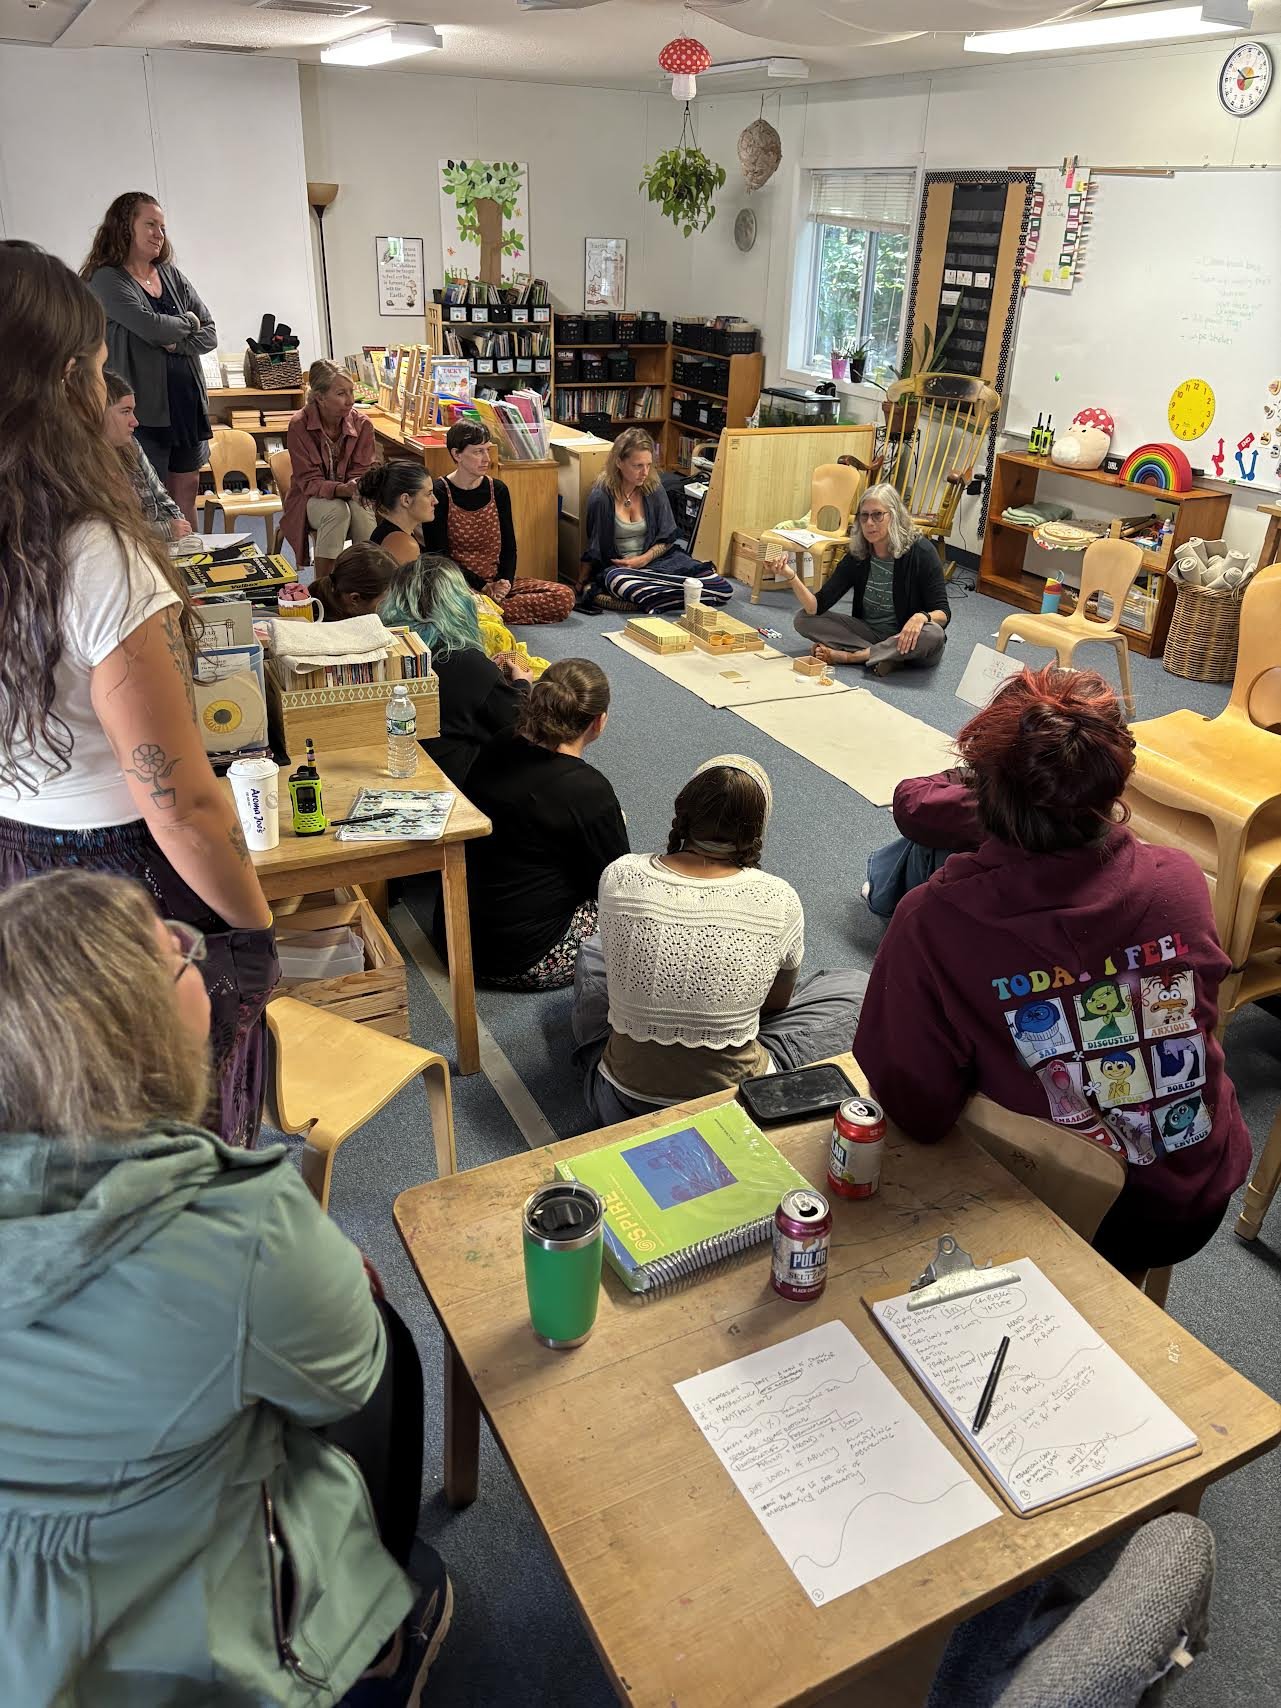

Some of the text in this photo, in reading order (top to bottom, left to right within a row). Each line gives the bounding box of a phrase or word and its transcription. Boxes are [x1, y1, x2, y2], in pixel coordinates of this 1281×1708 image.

[1241, 437, 1251, 447] END
[1107, 461, 1118, 471] JBL
[251, 788, 266, 834] Aroma Joe's
[1124, 933, 1189, 970] FEEL
[1151, 1021, 1191, 1037] ANXIOUS
[1087, 1034, 1135, 1049] DISGUSTED
[1039, 1047, 1057, 1058] SAD
[1166, 1081, 1196, 1093] BORED
[1113, 1094, 1143, 1106] JOYOUS
[1174, 1130, 1209, 1149] ENVIOUS
[606, 1190, 646, 1240] SPIRE
[793, 1250, 826, 1268] POLAR
